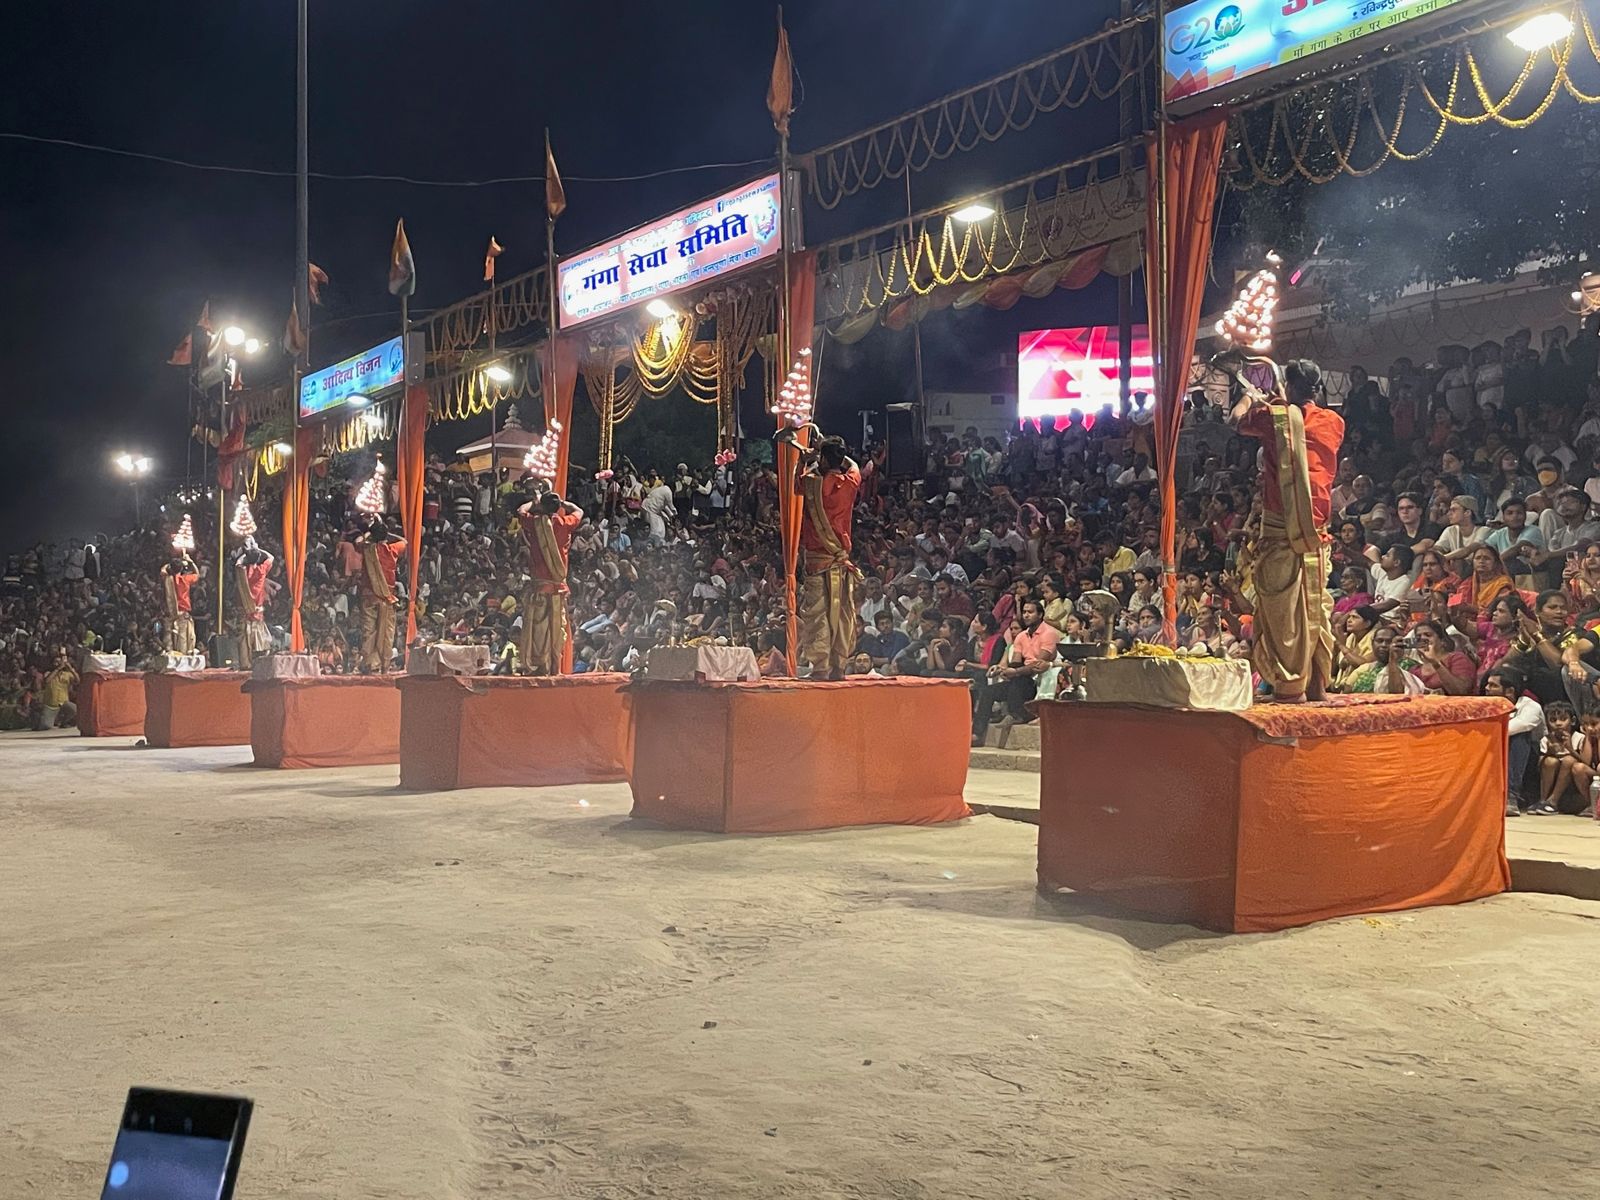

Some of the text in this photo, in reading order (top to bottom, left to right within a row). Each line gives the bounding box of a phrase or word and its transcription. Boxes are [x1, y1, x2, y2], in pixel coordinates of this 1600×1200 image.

[1168, 5, 1246, 55] G20
[582, 265, 620, 290] गंगा
[627, 246, 669, 276] सेवा
[676, 213, 749, 257] समिति
[322, 367, 354, 391] आदित्य
